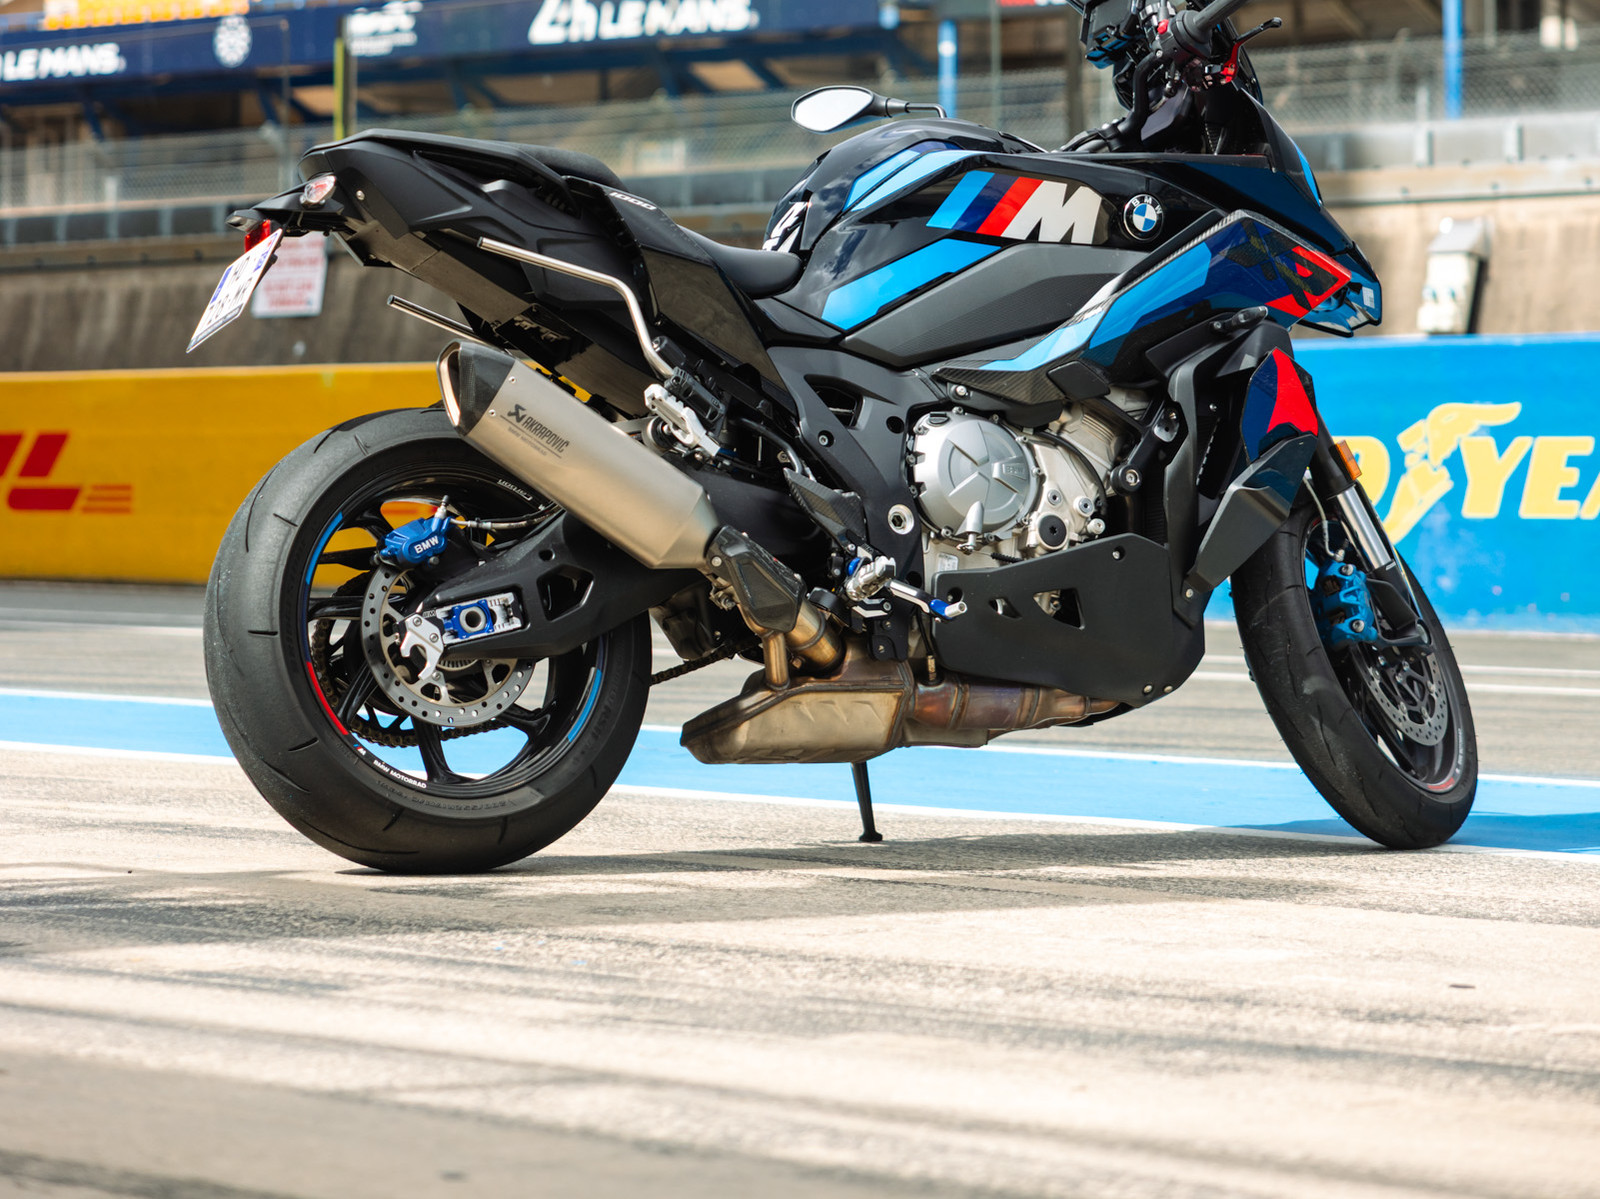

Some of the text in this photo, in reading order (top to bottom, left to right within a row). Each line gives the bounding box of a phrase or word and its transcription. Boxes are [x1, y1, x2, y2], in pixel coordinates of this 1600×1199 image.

[599, 0, 647, 40] LE
[2, 43, 119, 81] LE MANS
[609, 191, 657, 211] 1000
[1000, 179, 1102, 245] M
[1131, 196, 1162, 214] BMW
[414, 535, 440, 554] BMW
[373, 759, 390, 774] BMW
[389, 769, 428, 789] MOTORRAD
